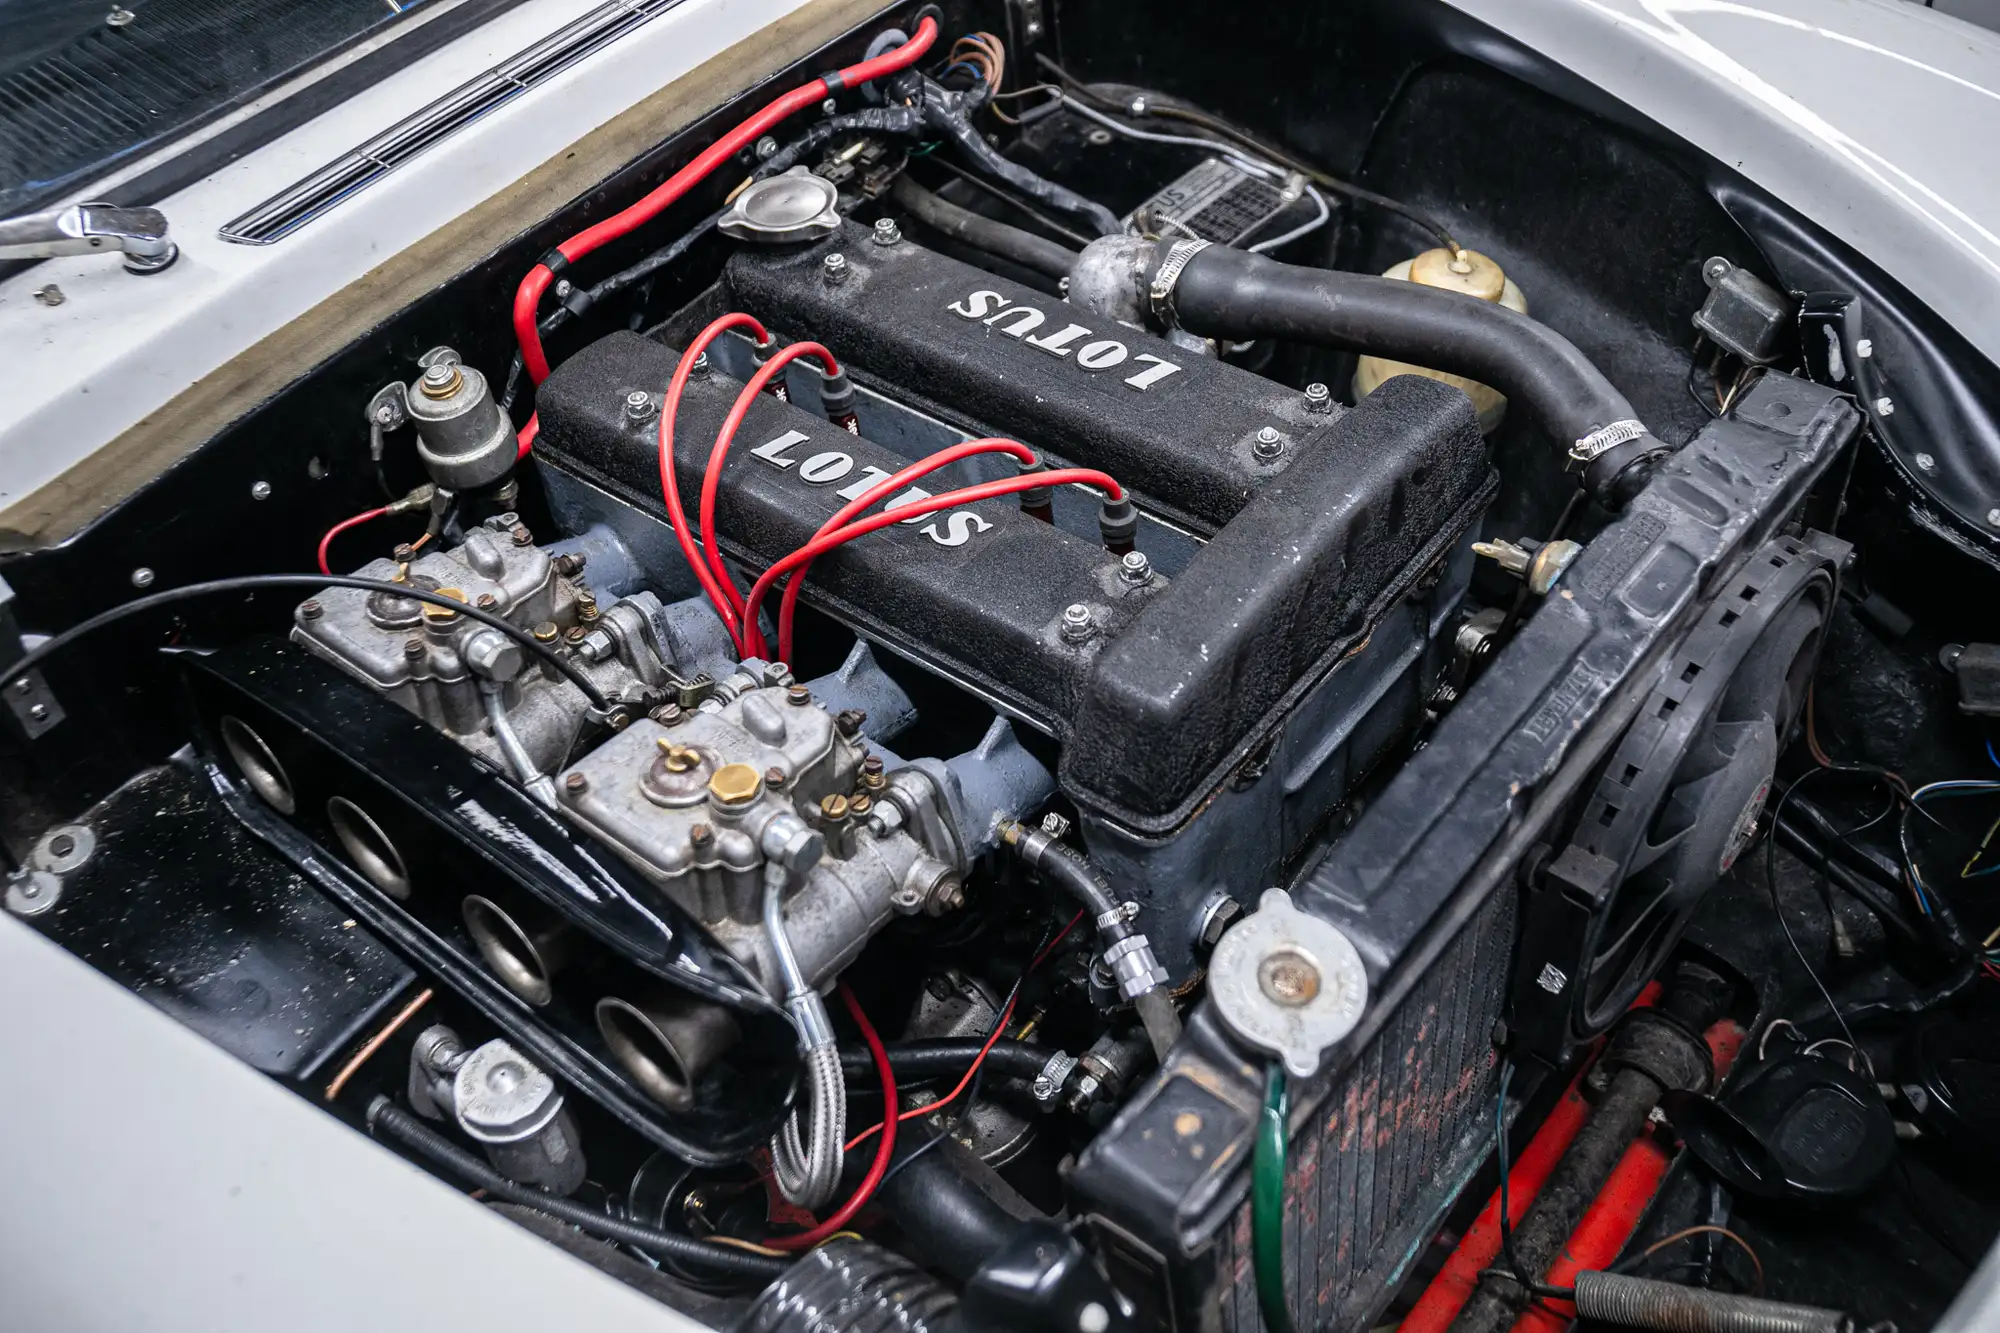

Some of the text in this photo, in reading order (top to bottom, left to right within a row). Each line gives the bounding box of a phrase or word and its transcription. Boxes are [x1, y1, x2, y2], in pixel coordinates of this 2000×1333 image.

[948, 290, 1182, 391] LOTUS
[1056, 843, 1120, 906] FUEL HOSE
